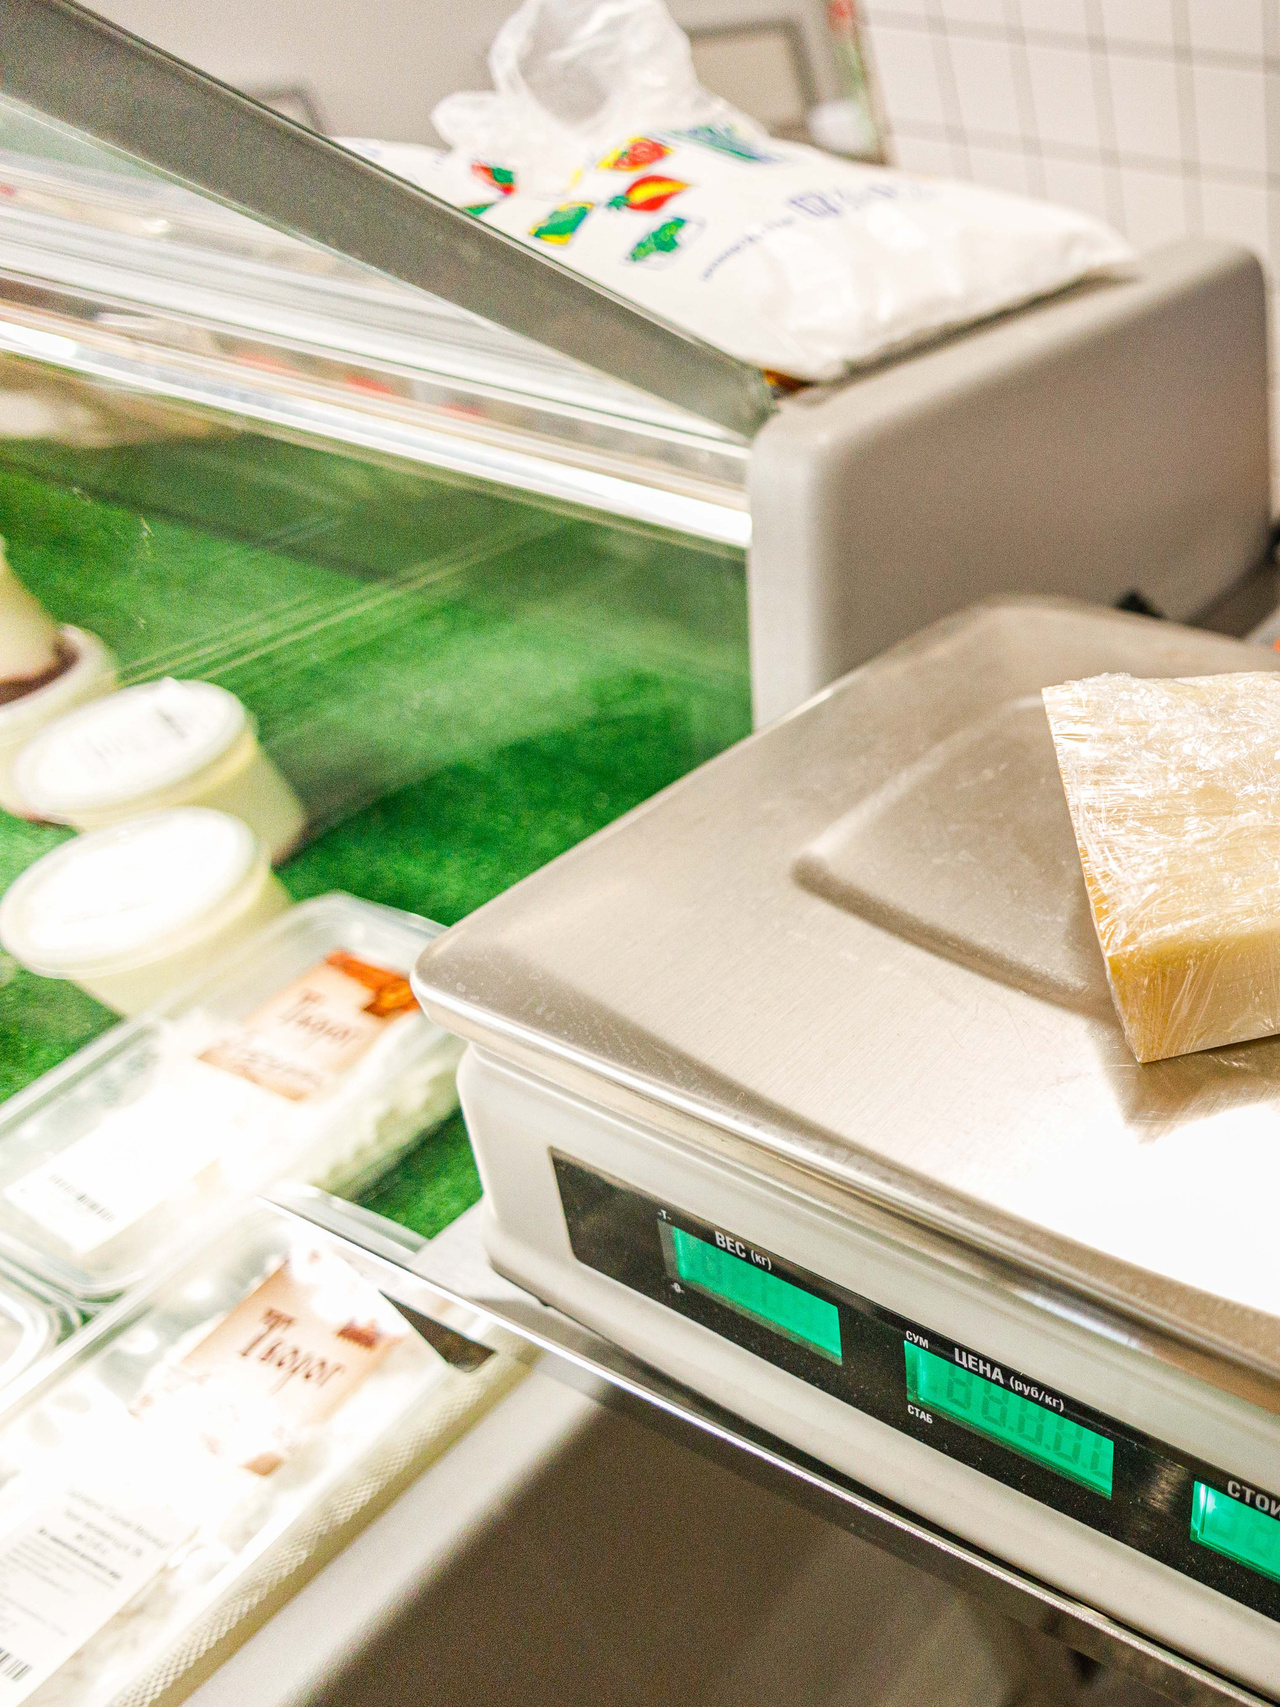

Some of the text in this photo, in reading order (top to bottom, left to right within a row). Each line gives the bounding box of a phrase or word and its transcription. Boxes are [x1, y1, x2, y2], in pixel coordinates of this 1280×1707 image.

[714, 1231, 772, 1271] ВЕС (кг)
[905, 1330, 929, 1349] СУМ
[954, 1347, 1065, 1412] ЦЕНА (руб/кг)
[907, 1404, 933, 1424] СТАБ
